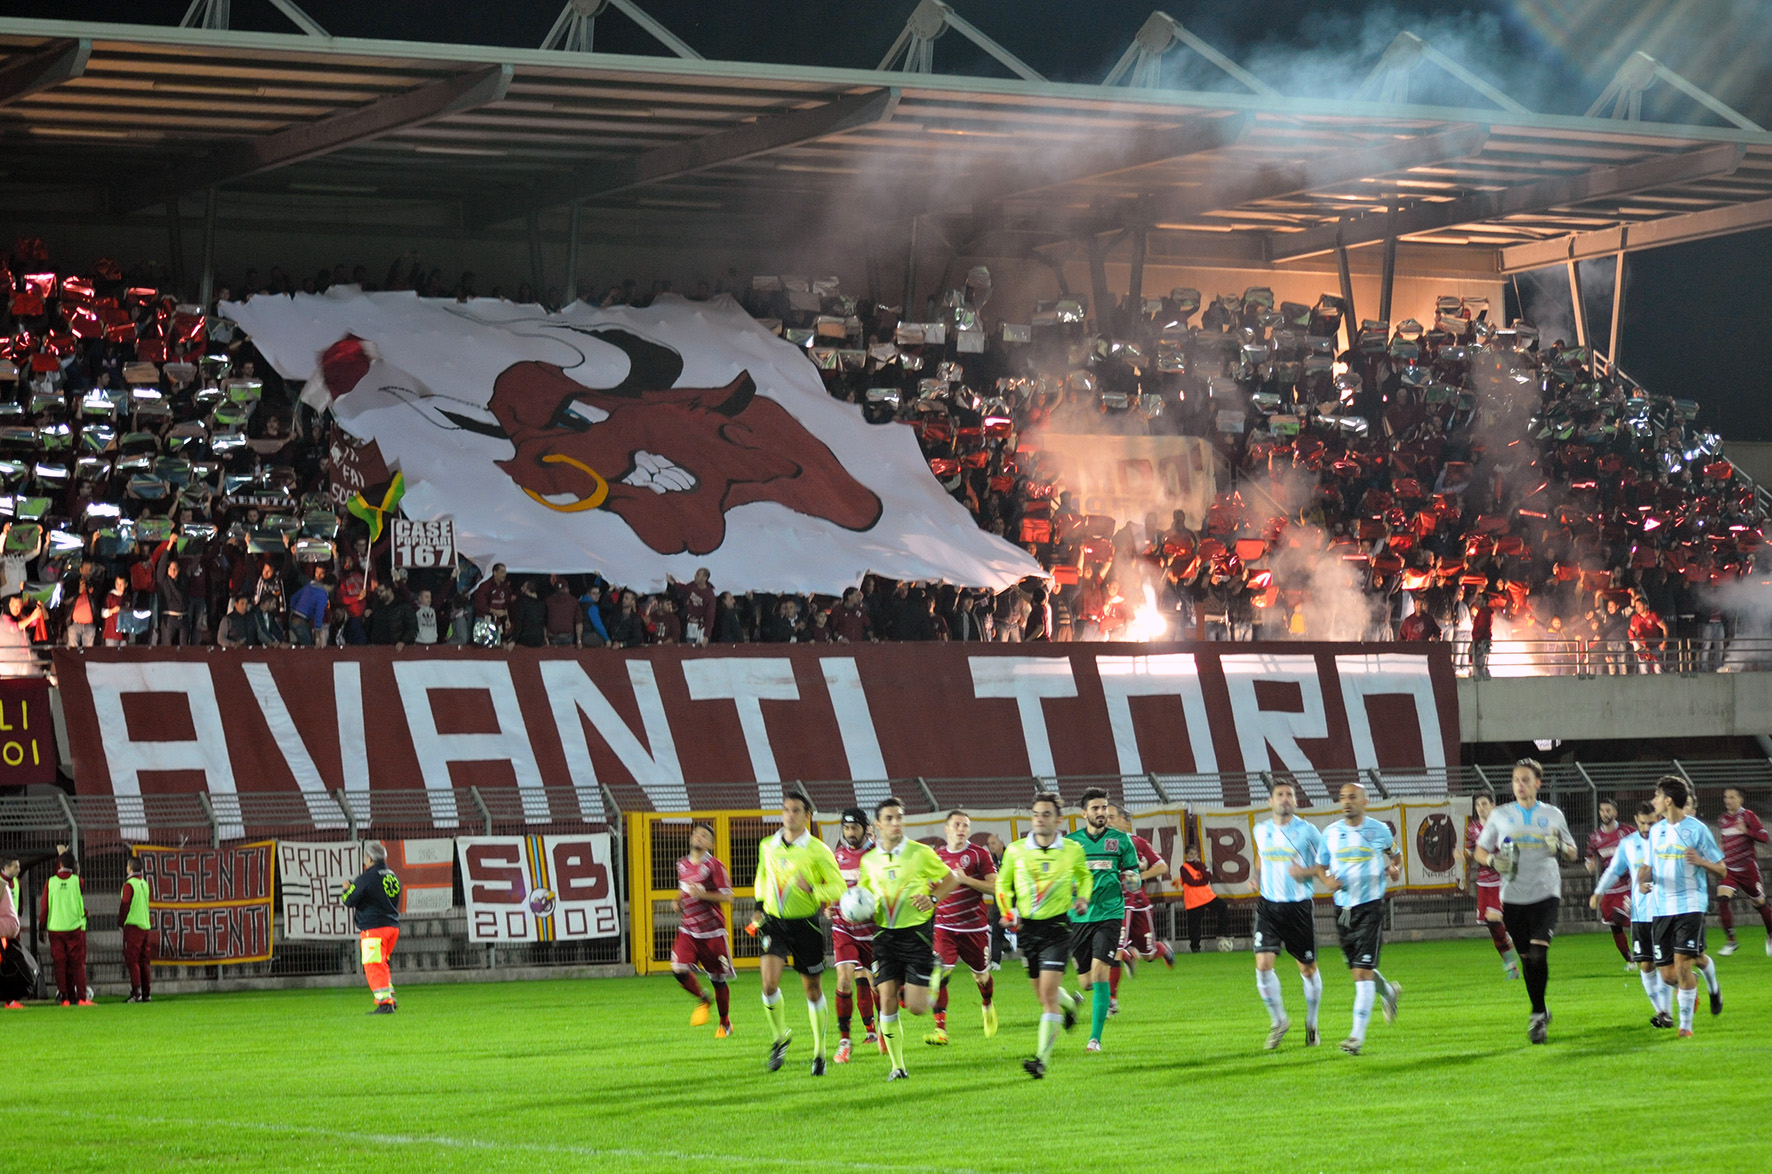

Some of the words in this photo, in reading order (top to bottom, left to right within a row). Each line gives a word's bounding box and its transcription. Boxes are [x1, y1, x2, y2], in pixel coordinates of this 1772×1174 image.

[396, 521, 452, 538] CASE
[396, 537, 451, 547] POPOLARI
[397, 546, 453, 568] 167
[86, 655, 893, 841] AVANTI
[967, 652, 1448, 808] TORO
[140, 847, 266, 902] ASSENTI
[310, 877, 340, 905] AL
[1633, 940, 1642, 954] 4
[1654, 944, 1663, 960] 5
